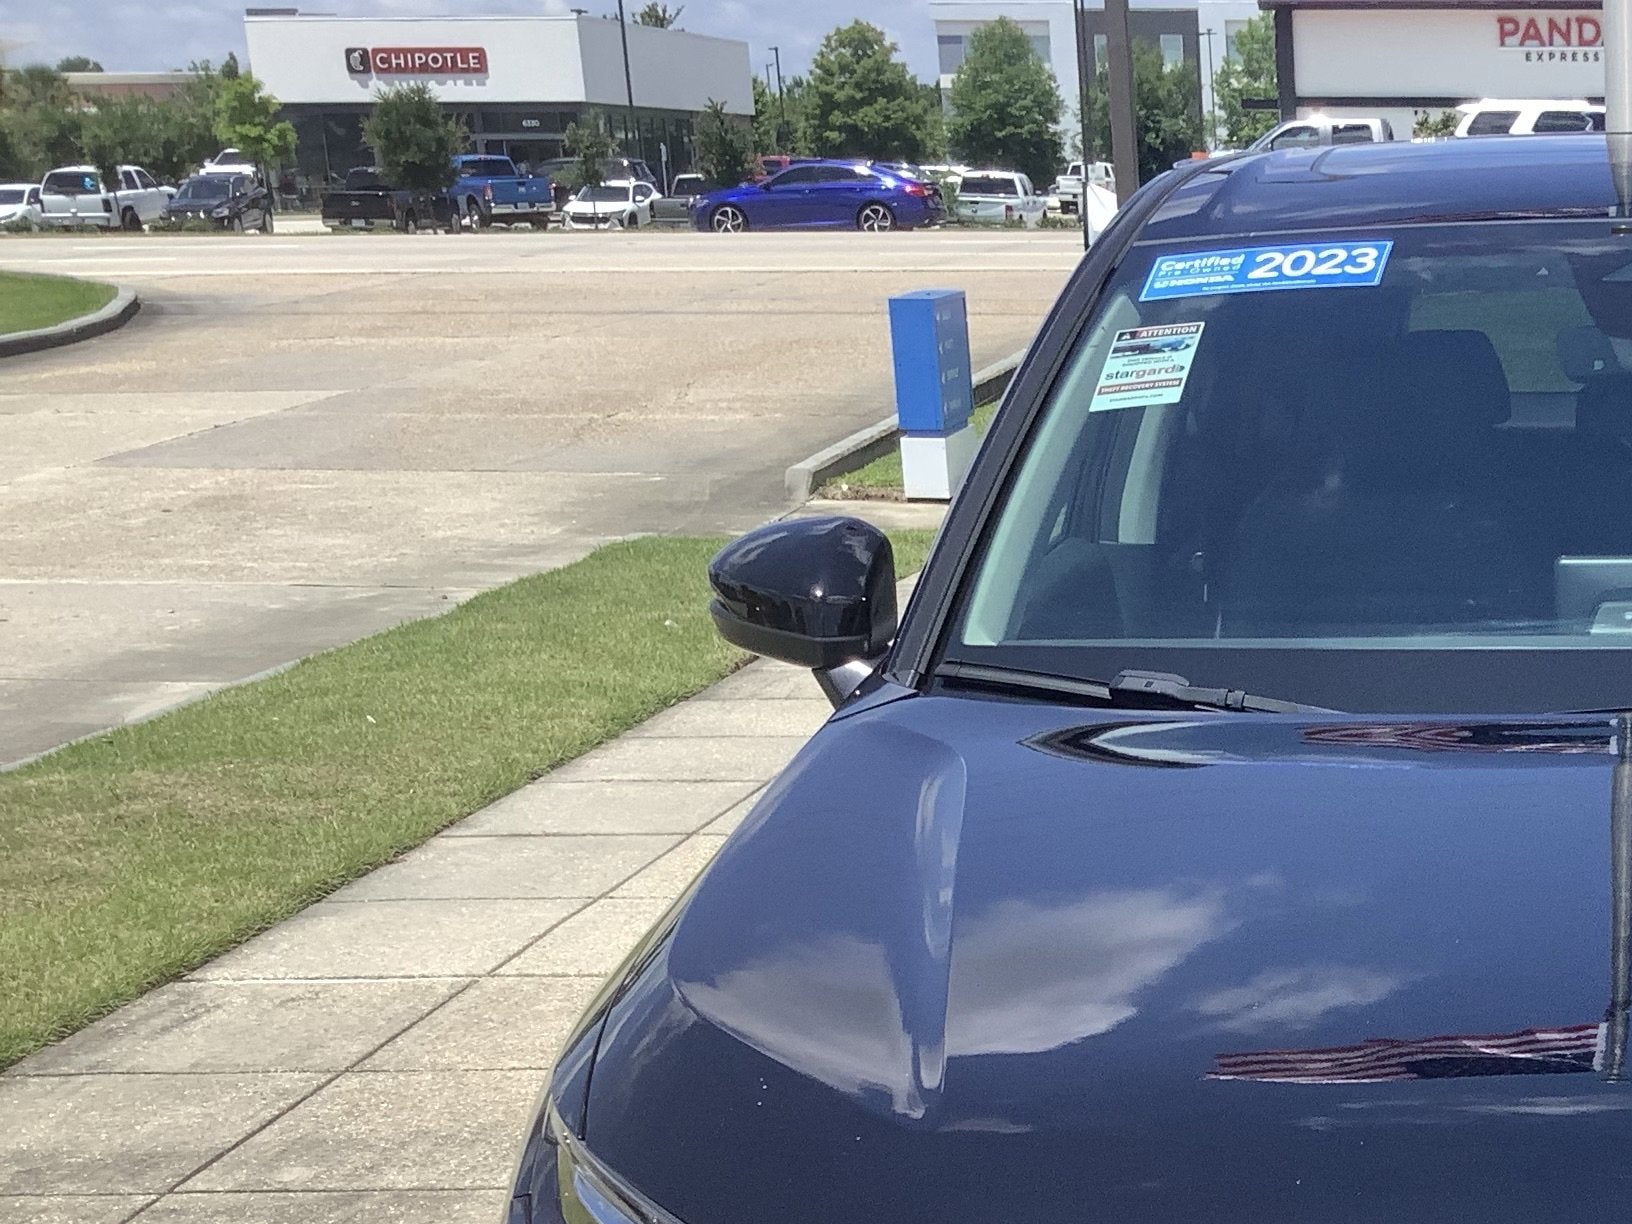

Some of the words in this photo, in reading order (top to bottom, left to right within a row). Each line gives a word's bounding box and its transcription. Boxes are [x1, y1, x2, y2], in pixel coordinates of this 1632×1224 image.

[1497, 15, 1604, 48] PAND
[375, 52, 481, 69] CHIPOTLE
[1525, 51, 1600, 62] EXPRESS
[1160, 254, 1245, 271] Certified
[1247, 247, 1379, 279] 2023
[1141, 326, 1197, 337] ATTENTION
[1105, 364, 1176, 381] stargard
